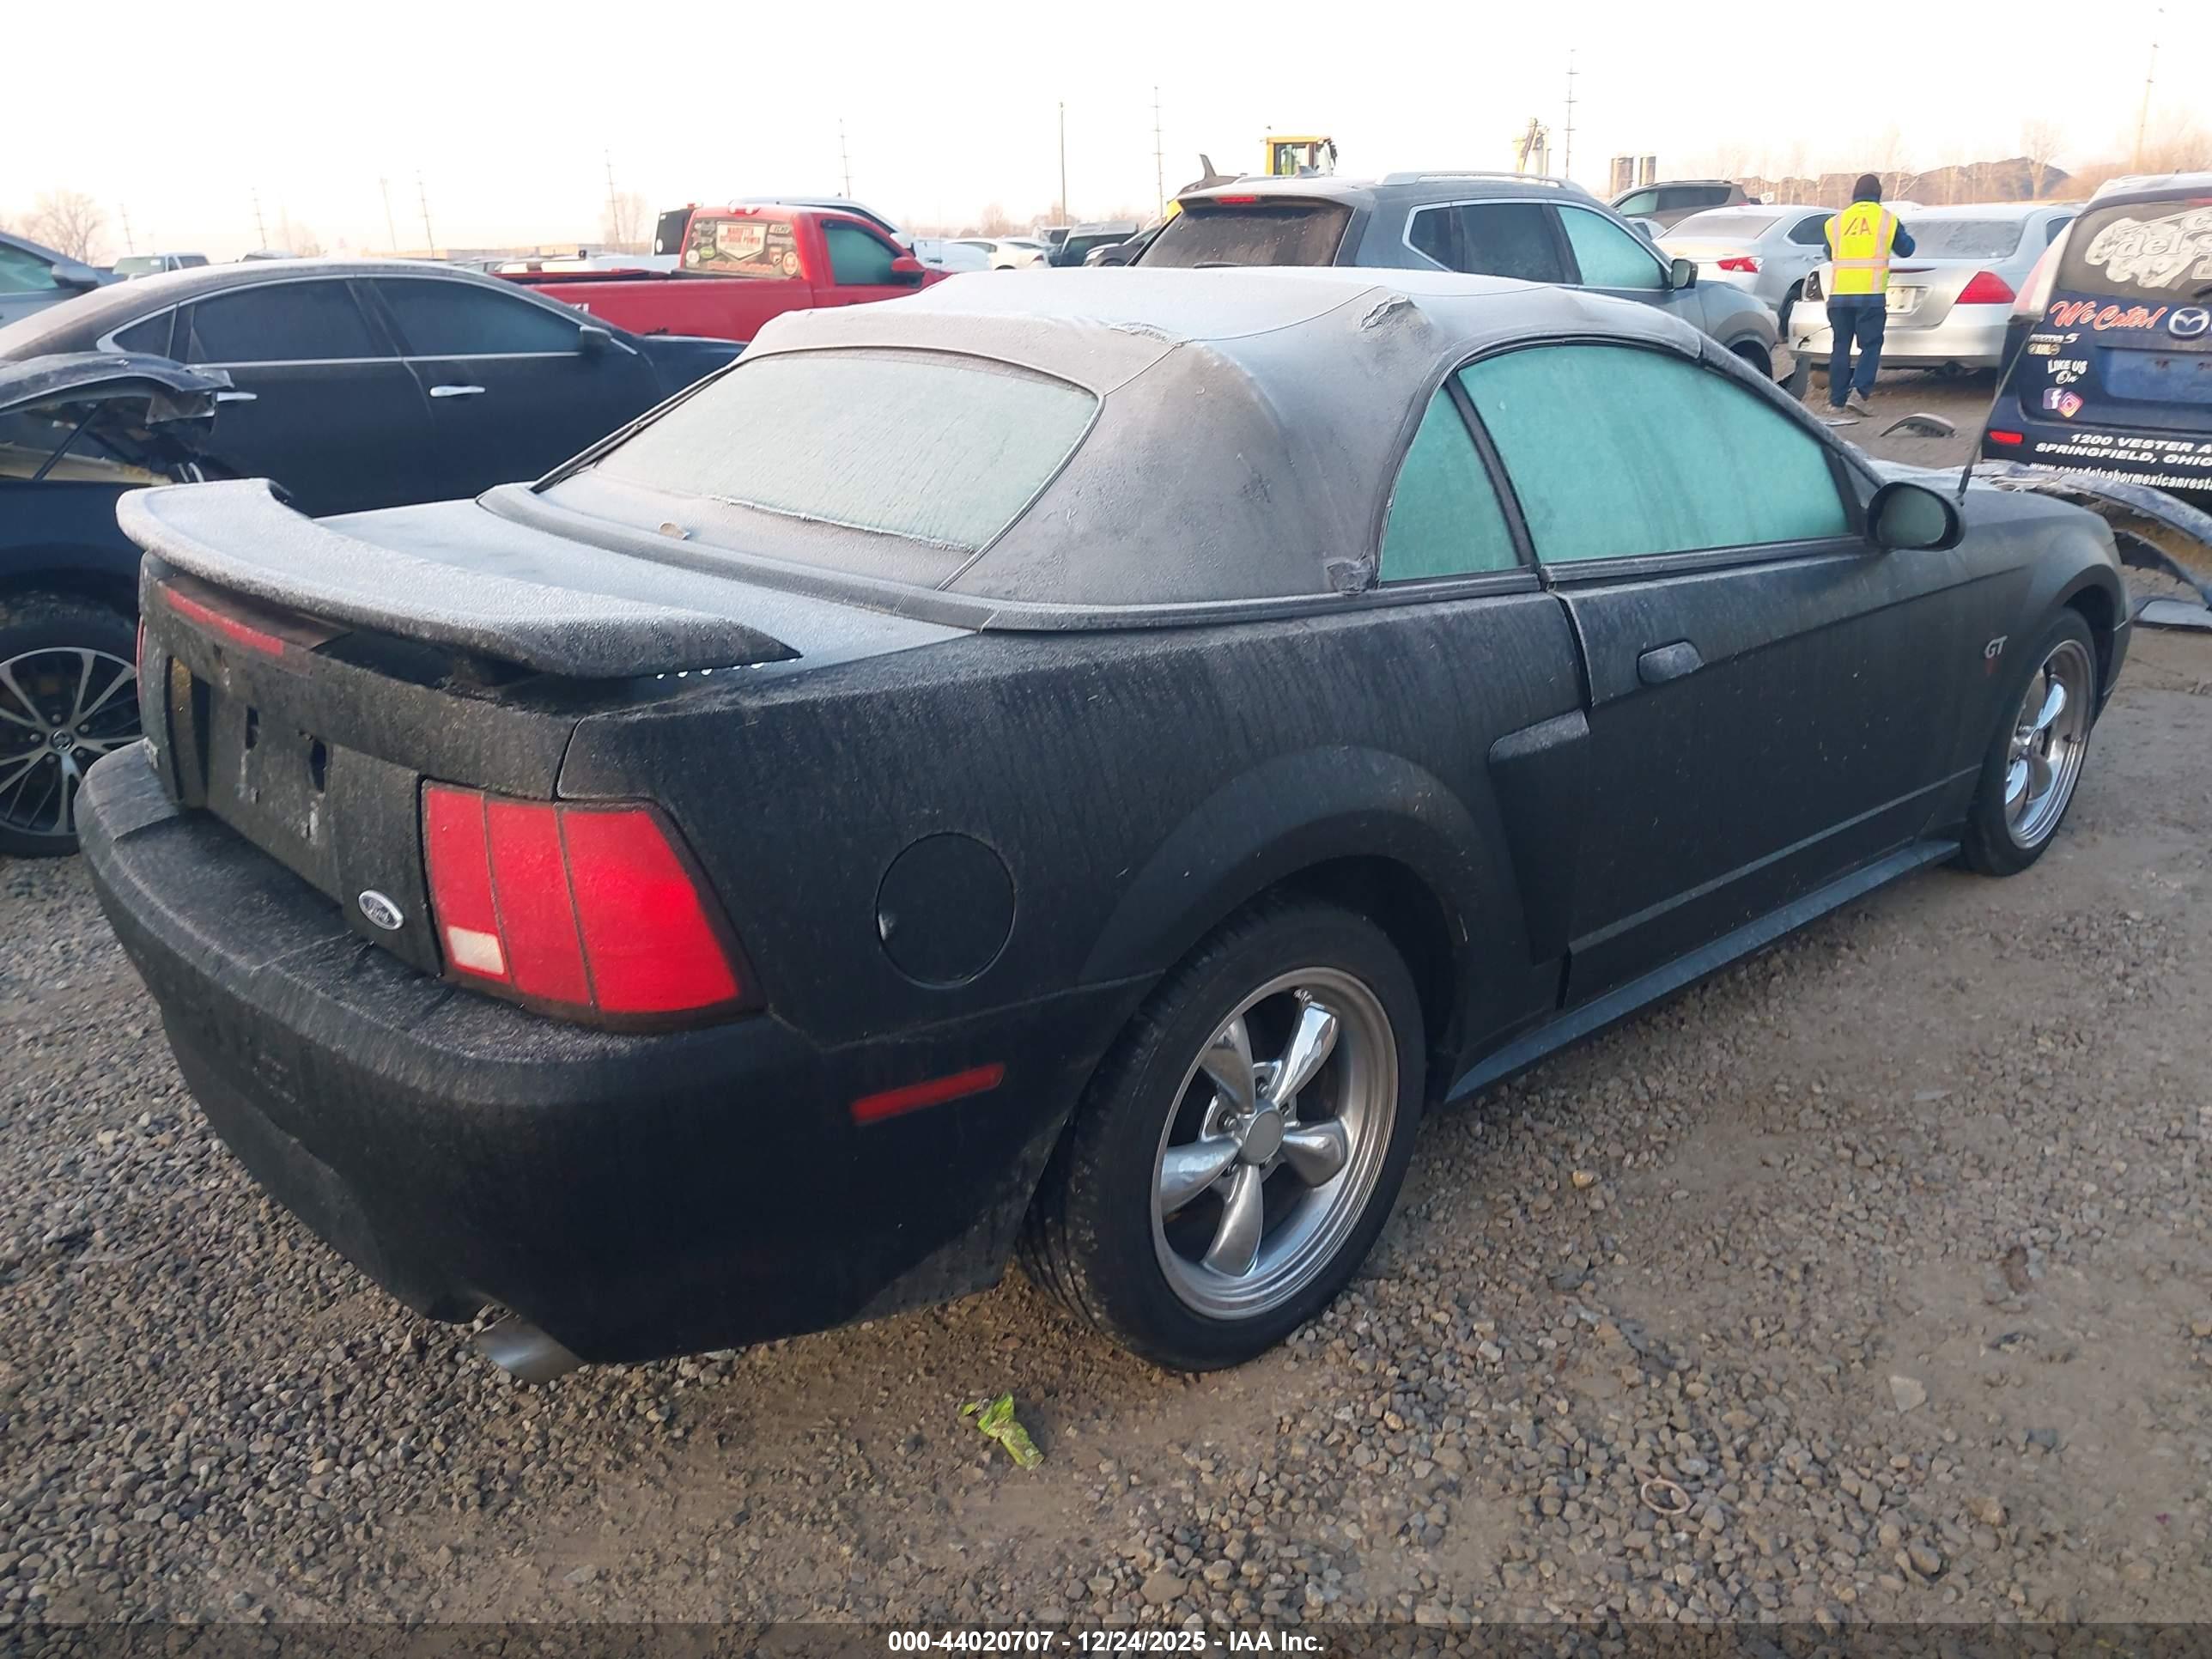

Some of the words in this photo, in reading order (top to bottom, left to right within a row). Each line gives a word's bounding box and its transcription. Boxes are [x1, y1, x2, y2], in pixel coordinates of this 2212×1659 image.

[2049, 300, 2098, 327] We
[2047, 359, 2072, 374] LIKE
[2071, 360, 2088, 375] US
[2055, 370, 2081, 385] On
[2034, 441, 2158, 465] SPRINGFIELD,
[2070, 433, 2114, 447] 1200
[2117, 436, 2195, 453] VESTER
[1984, 635, 2008, 659] GT
